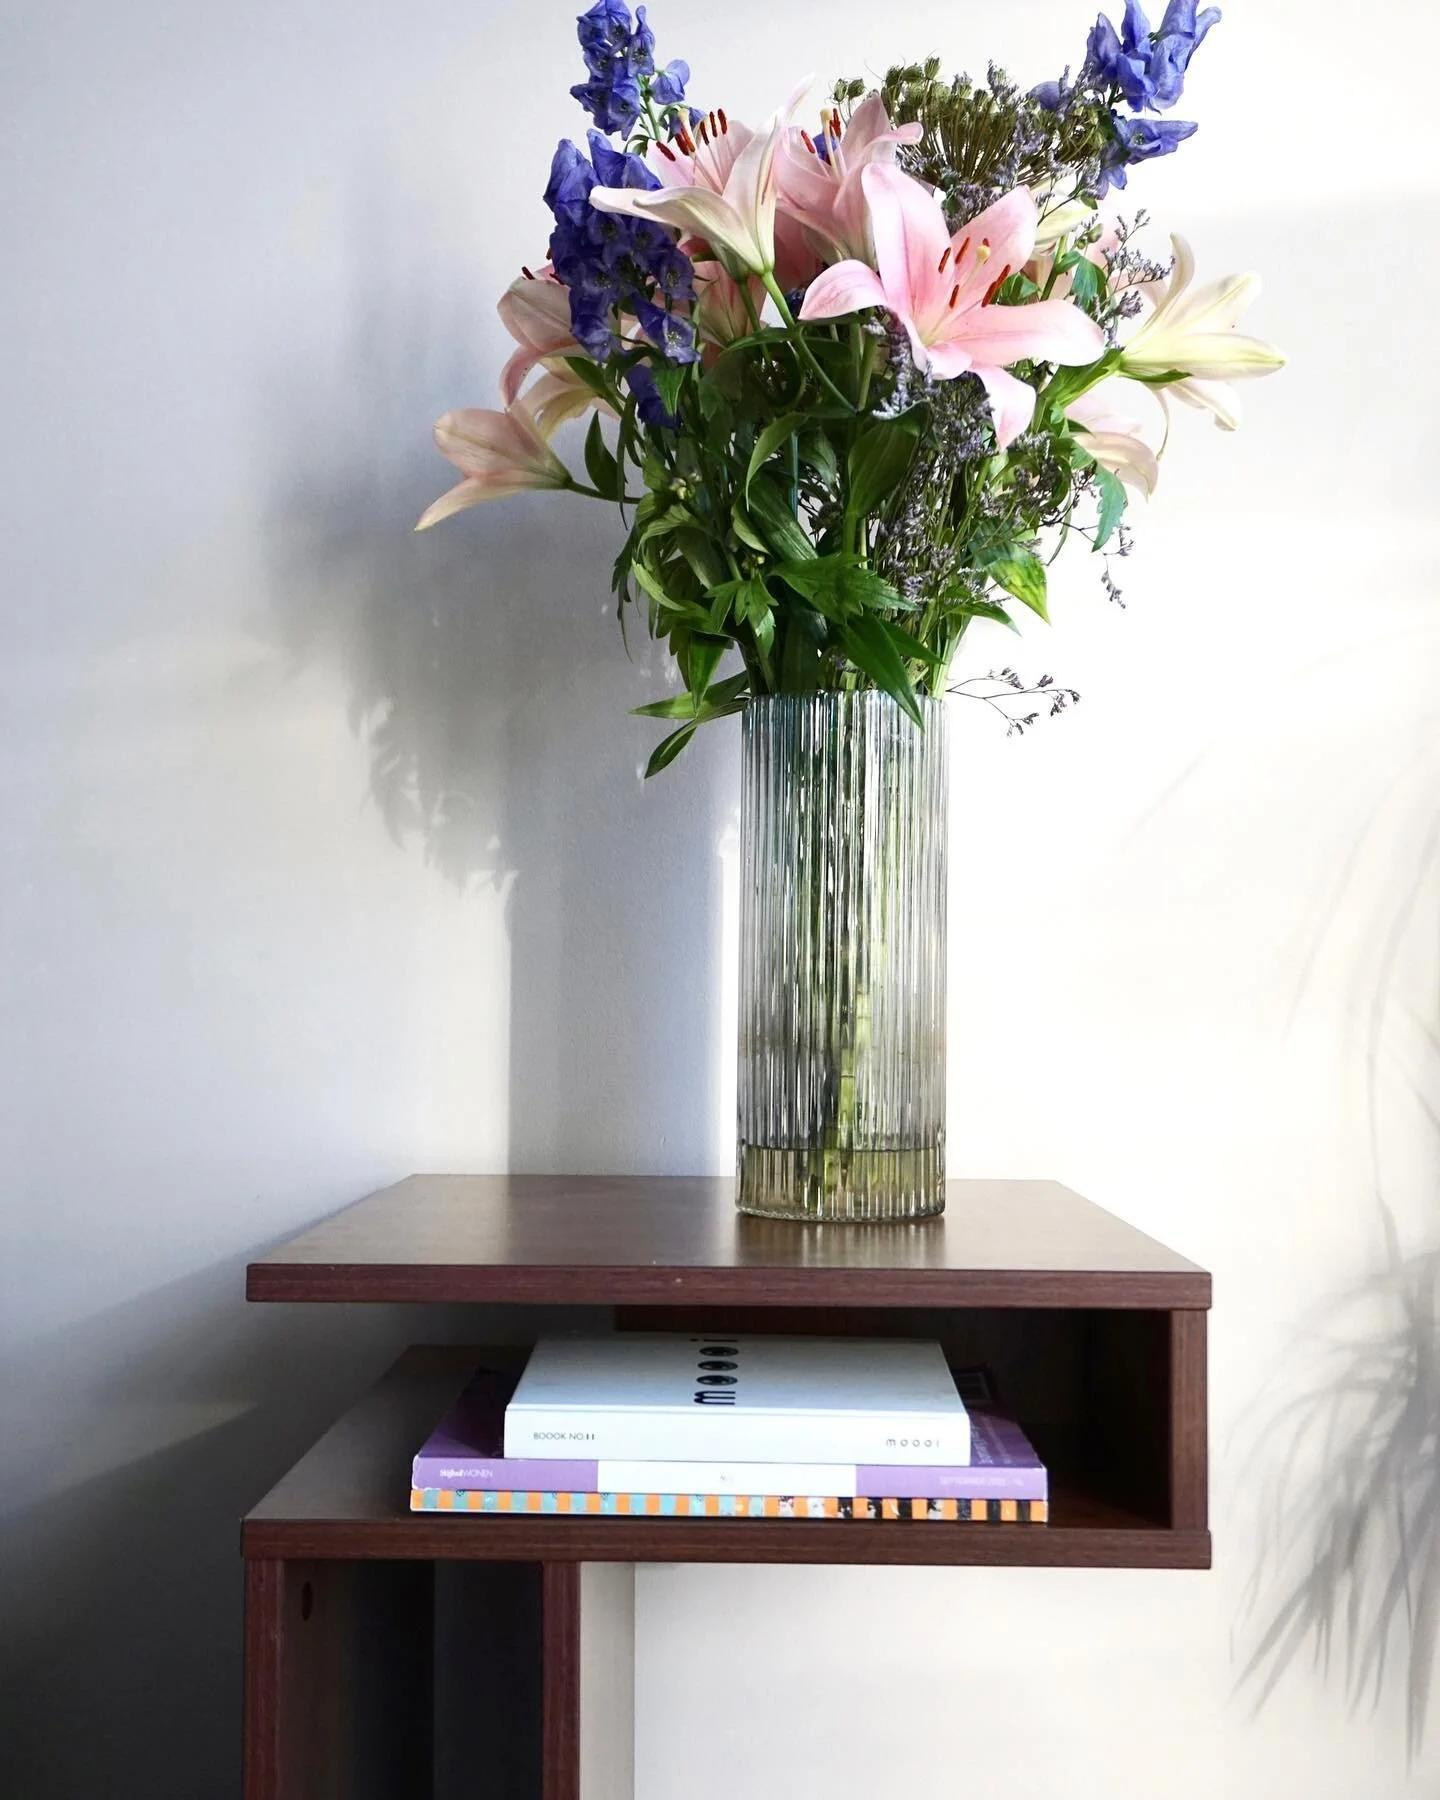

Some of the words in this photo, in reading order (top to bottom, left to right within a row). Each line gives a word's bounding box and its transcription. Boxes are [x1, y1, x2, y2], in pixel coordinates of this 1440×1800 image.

[689, 1338, 740, 1405] moooi
[533, 1431, 567, 1441] BOOOK
[886, 1438, 940, 1449] moooi
